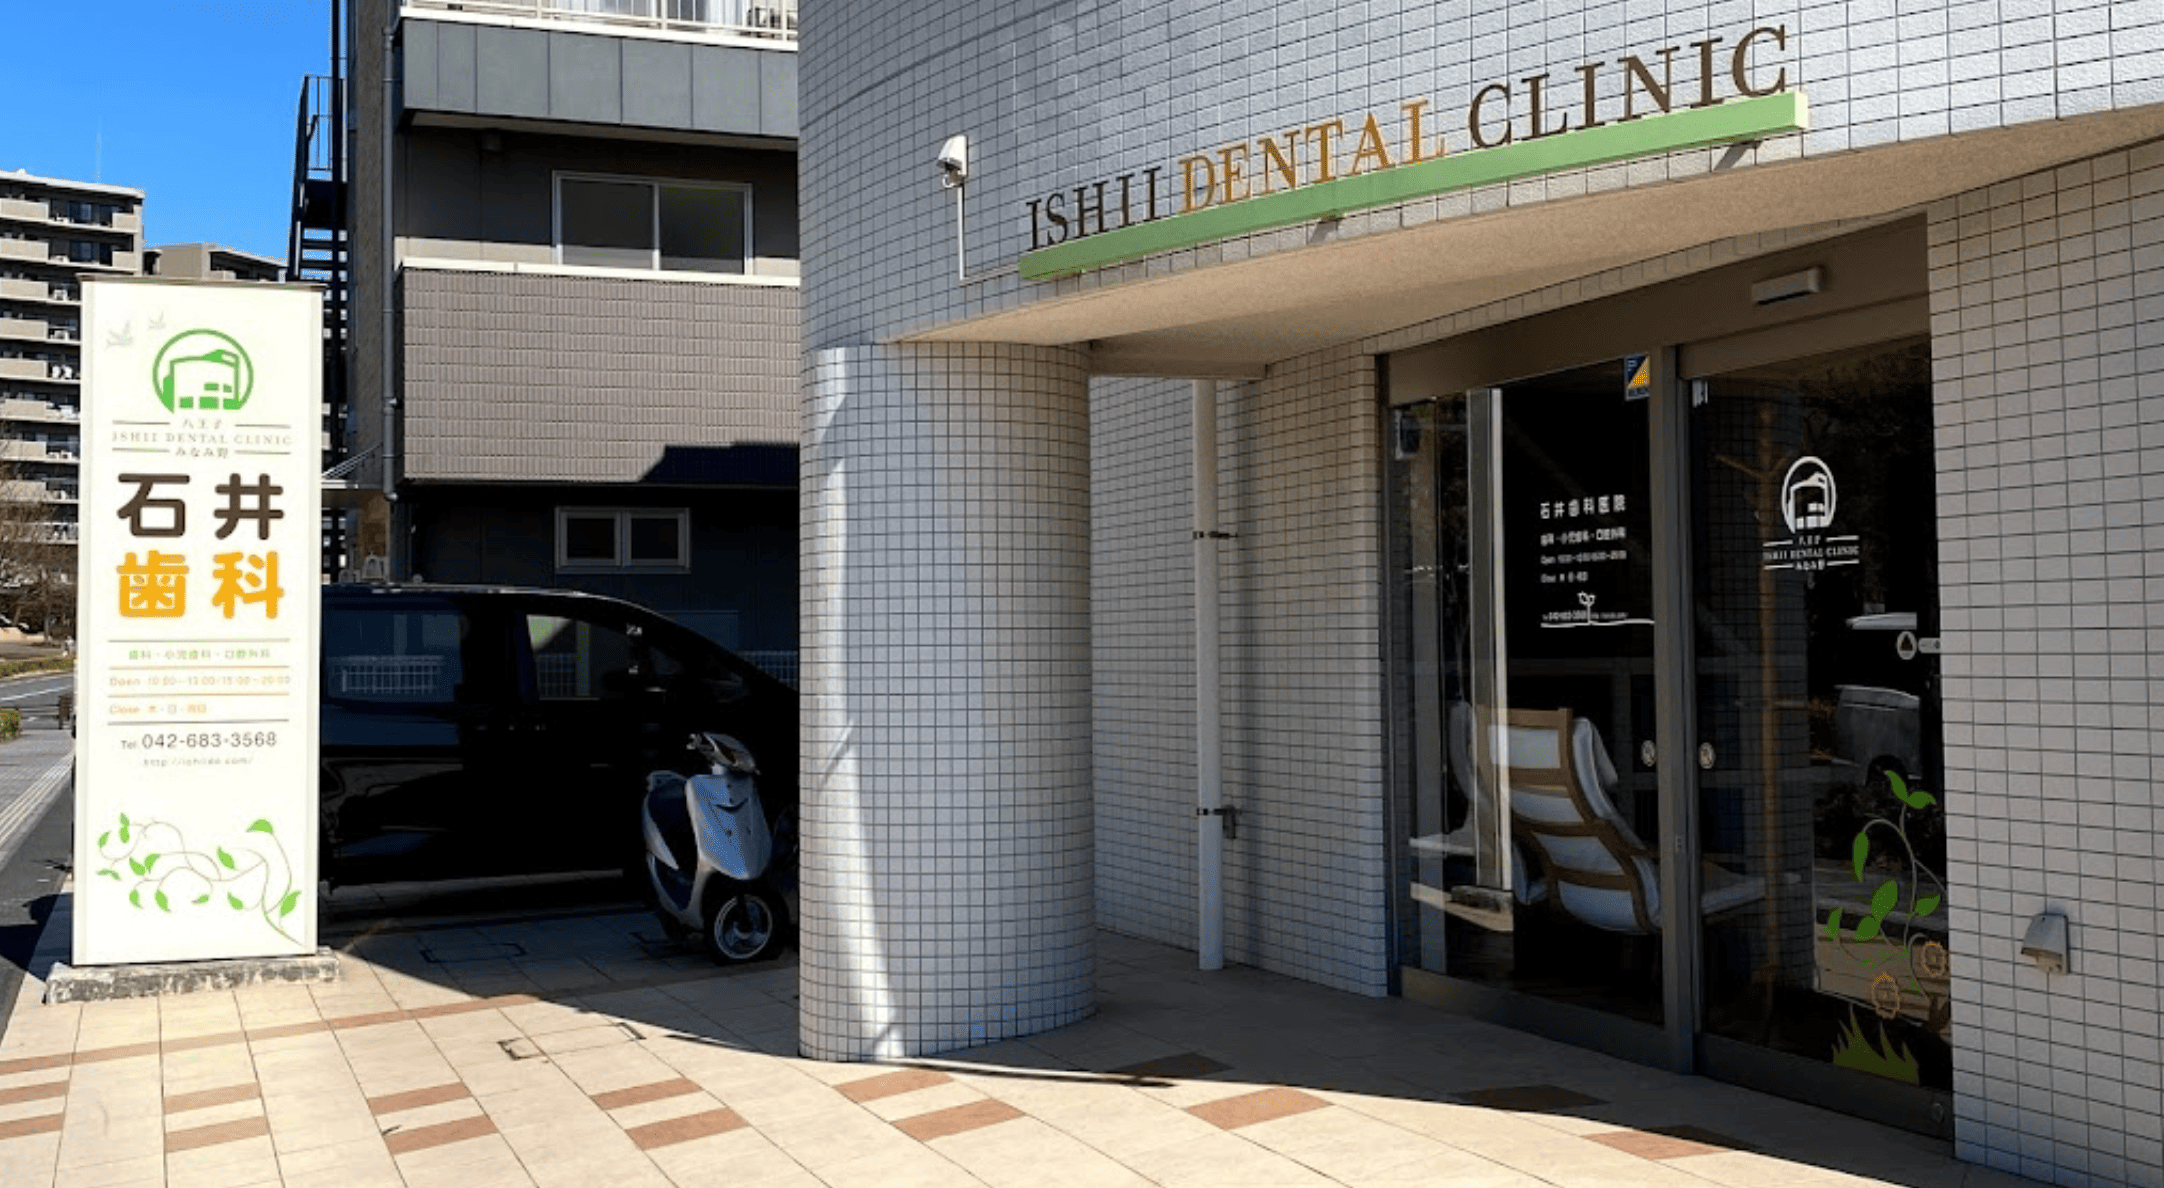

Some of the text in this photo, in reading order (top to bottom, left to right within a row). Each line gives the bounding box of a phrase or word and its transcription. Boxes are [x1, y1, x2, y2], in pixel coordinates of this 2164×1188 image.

[1026, 24, 1786, 252] ISHII DENTAL CLINIC
[112, 431, 293, 445] ISHII DENTAL CLINIC
[116, 472, 285, 540] 石井
[116, 550, 285, 619] 歯科
